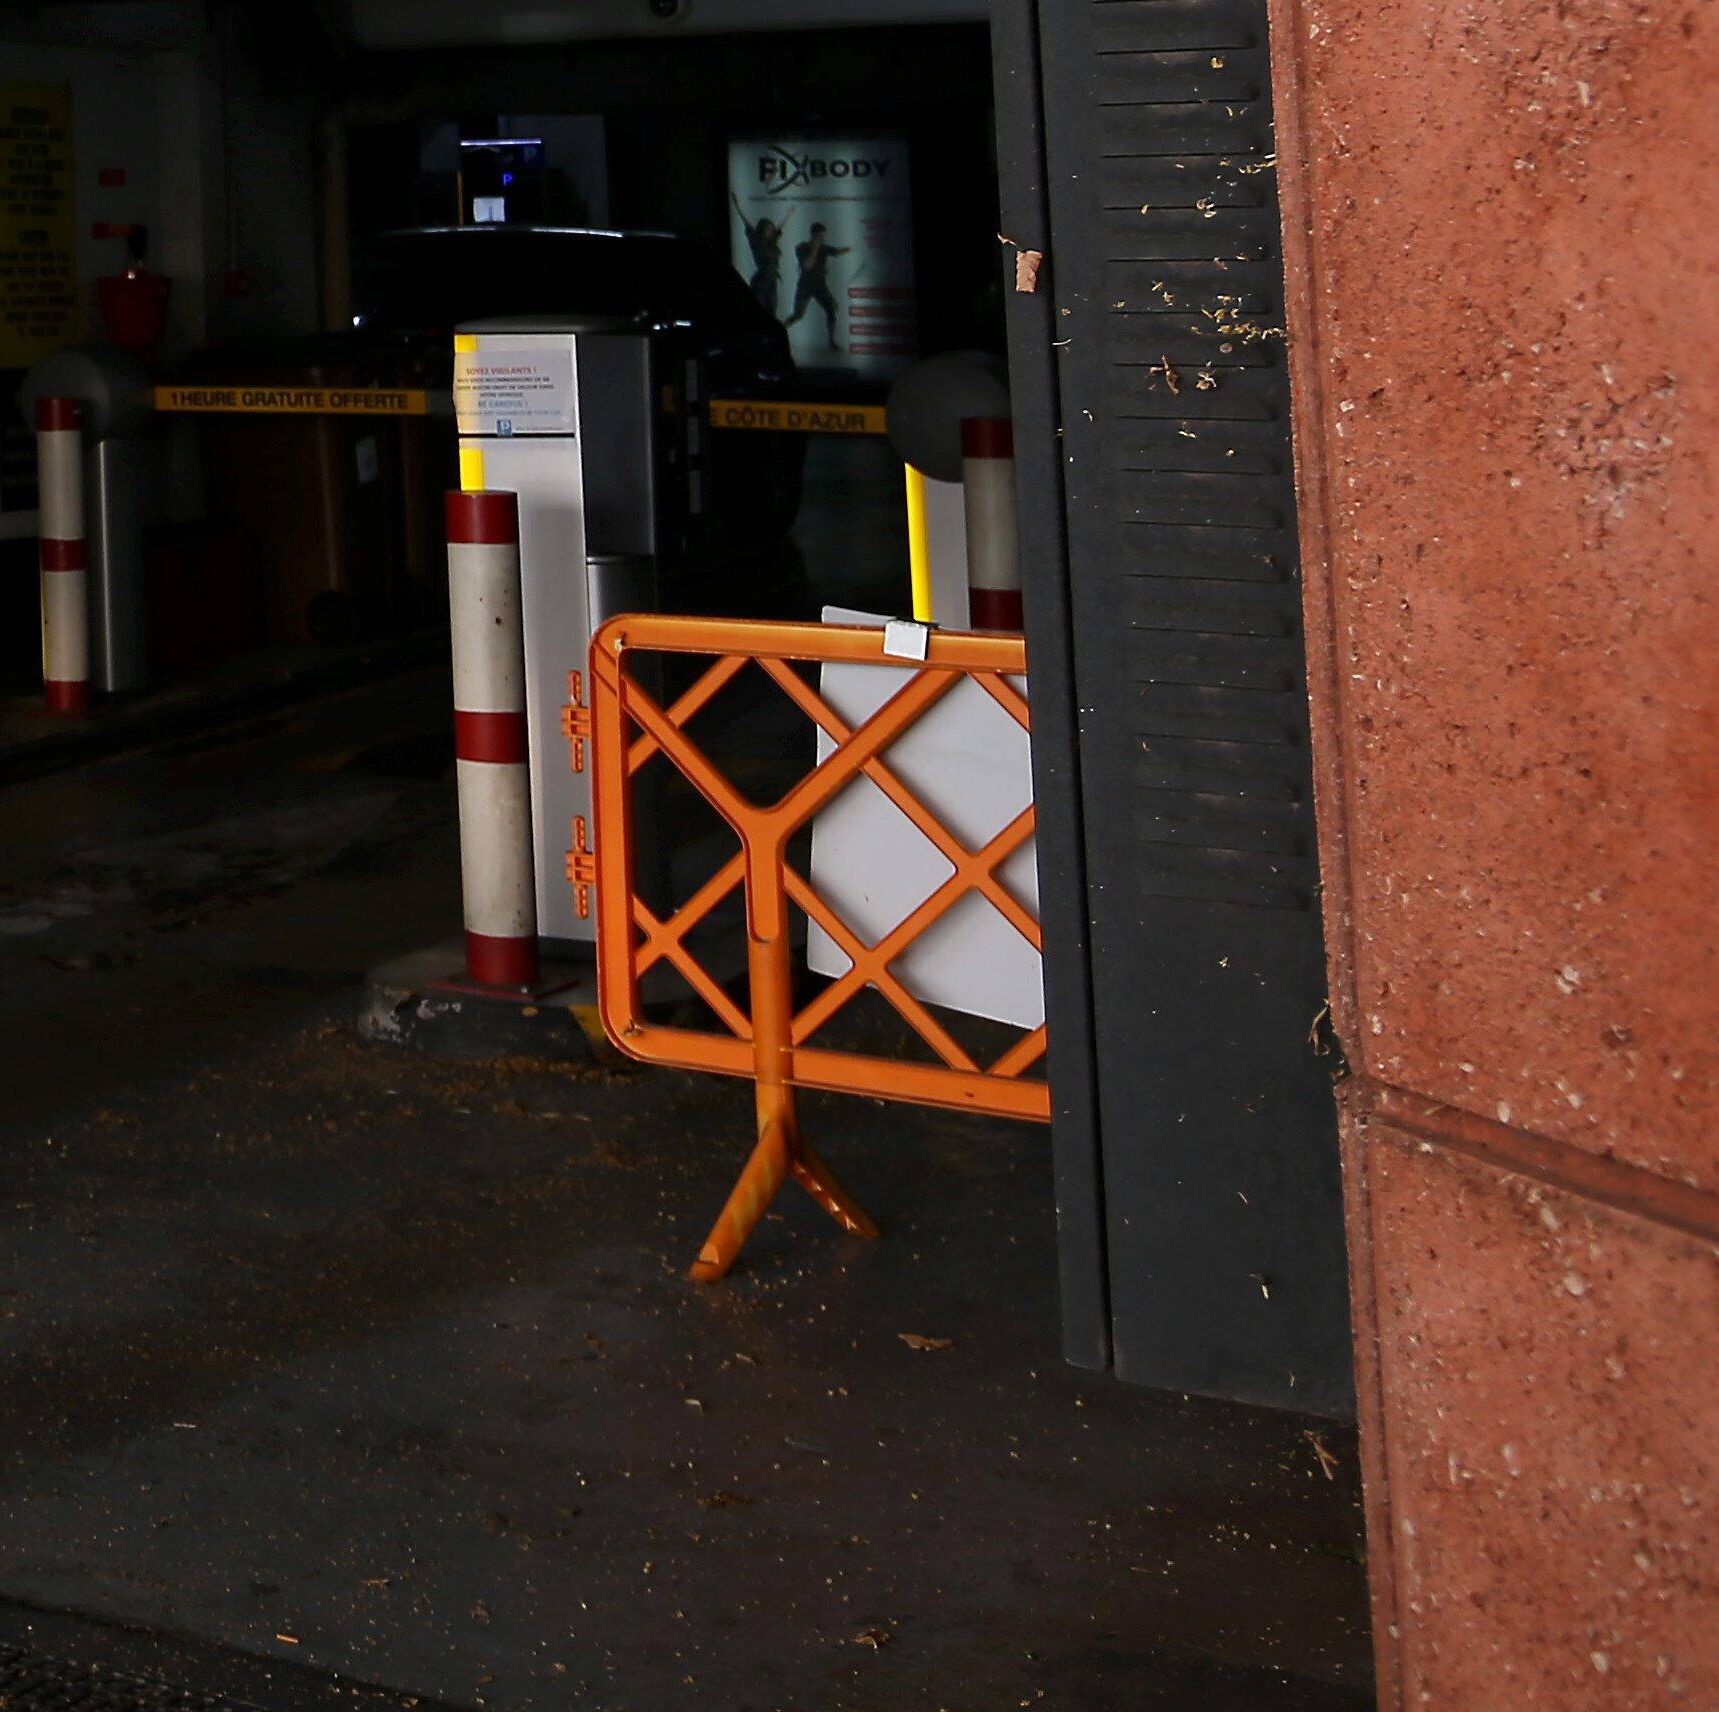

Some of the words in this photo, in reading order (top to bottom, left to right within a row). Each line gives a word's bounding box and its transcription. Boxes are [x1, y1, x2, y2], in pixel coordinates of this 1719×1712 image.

[180, 391, 236, 408] HEURE
[241, 391, 325, 408] GRATUITE
[330, 392, 409, 409] OFFERTE
[725, 402, 780, 426] CÔTE
